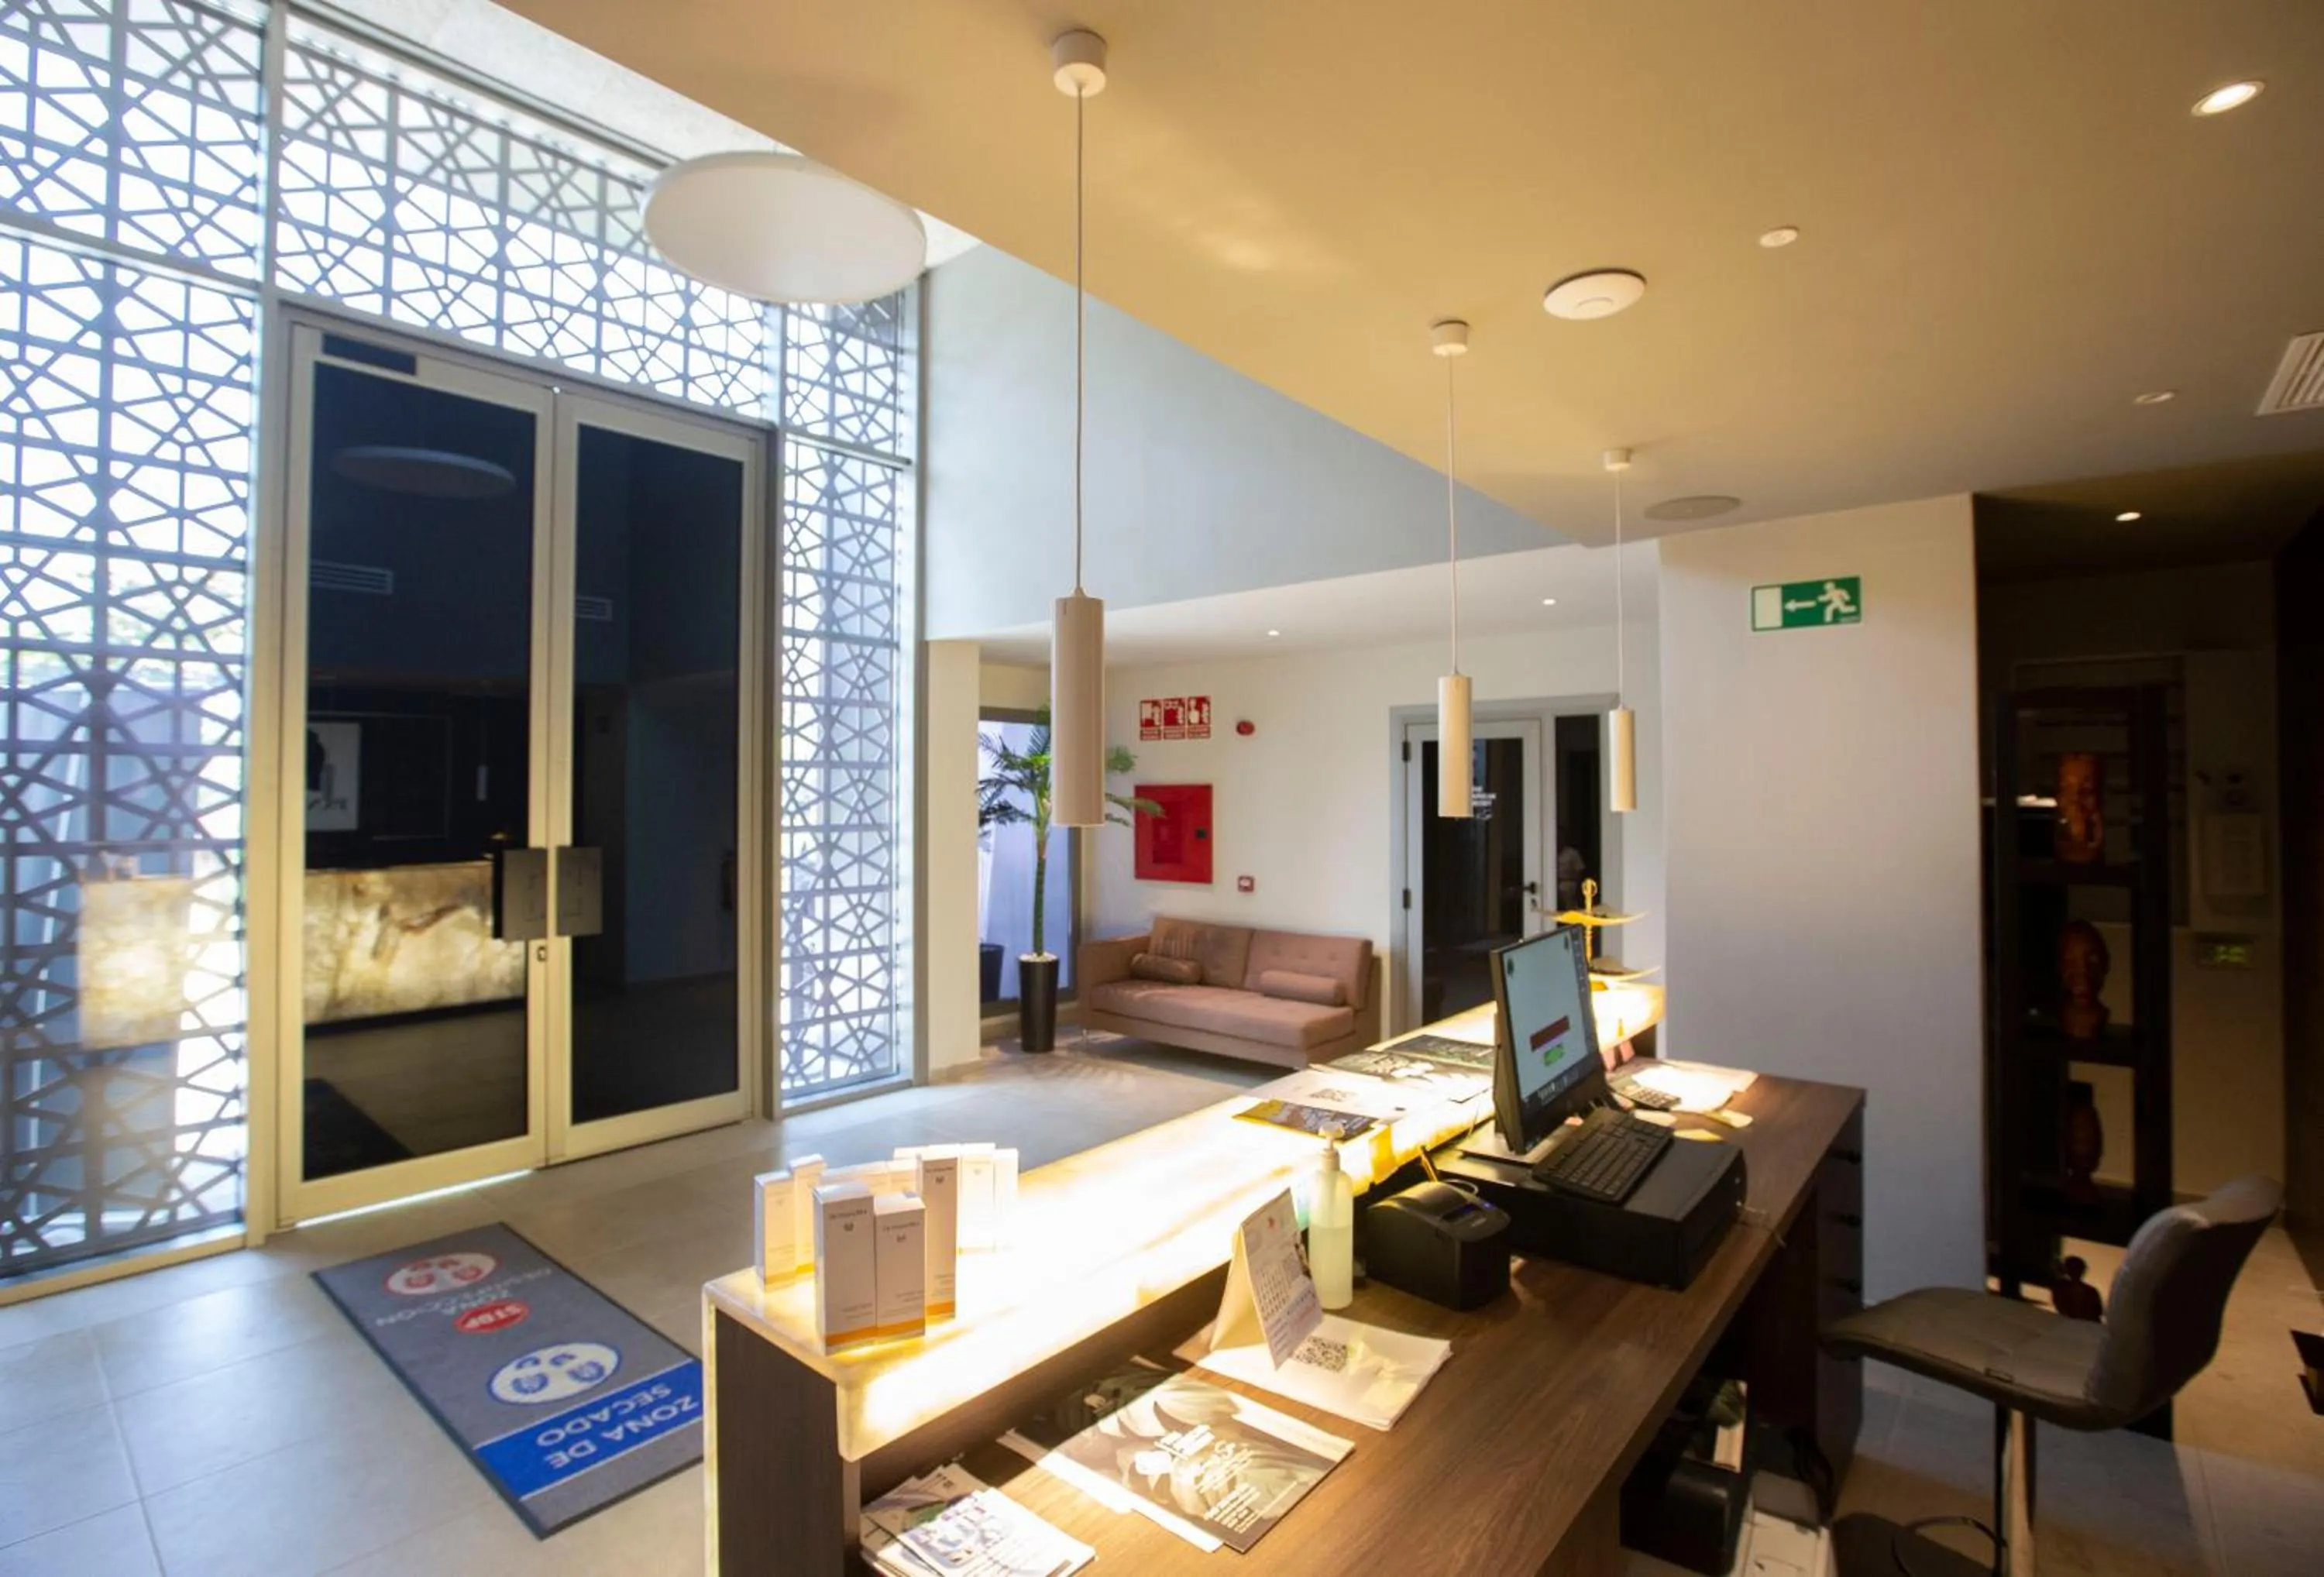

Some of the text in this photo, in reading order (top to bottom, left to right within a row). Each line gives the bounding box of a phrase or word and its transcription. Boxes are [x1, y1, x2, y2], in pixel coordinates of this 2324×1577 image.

[464, 1301, 522, 1330] STOP
[537, 1383, 671, 1446] SECADO
[545, 1395, 699, 1470] ZONA DE
